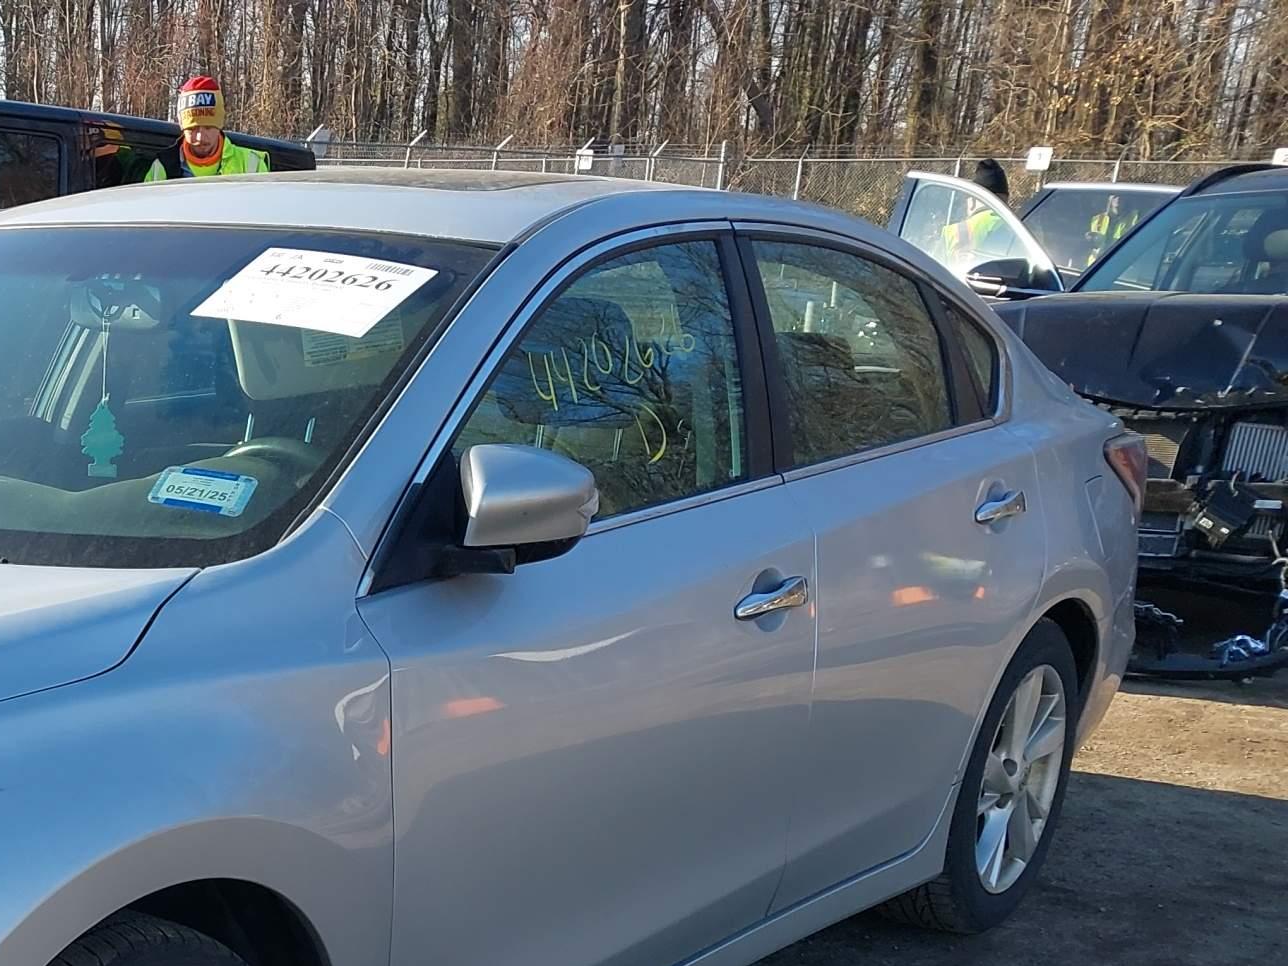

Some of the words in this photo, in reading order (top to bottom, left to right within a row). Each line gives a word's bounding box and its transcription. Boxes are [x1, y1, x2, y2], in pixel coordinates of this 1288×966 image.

[188, 92, 213, 107] BAY
[260, 263, 399, 292] 44202626
[165, 484, 228, 502] 05/21/25
